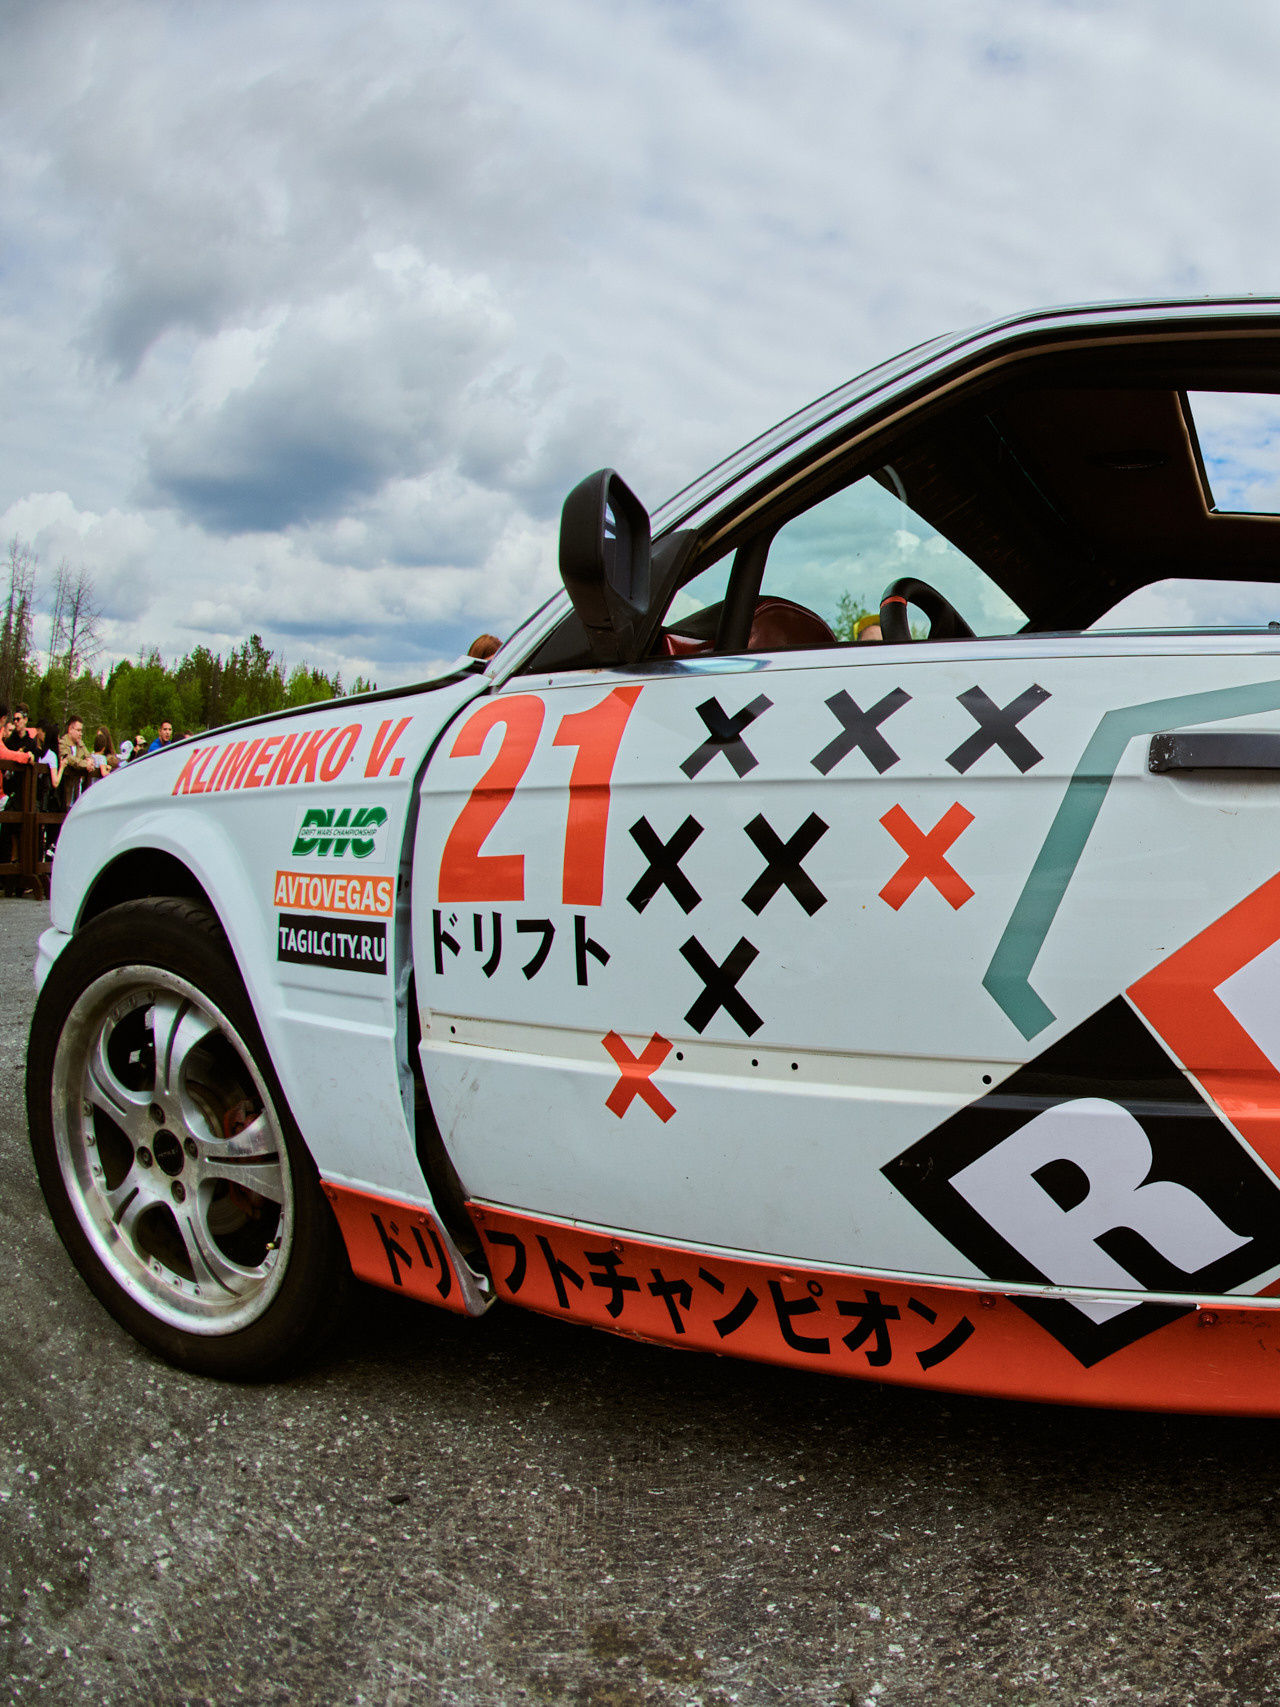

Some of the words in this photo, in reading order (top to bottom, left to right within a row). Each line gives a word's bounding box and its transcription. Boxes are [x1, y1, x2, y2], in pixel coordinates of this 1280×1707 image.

[172, 723, 362, 795] KLIMENKO
[364, 716, 414, 778] V.
[437, 685, 644, 906] 21
[291, 806, 388, 859] DWC
[275, 876, 391, 912] AVTOVEGAS
[279, 927, 386, 962] TAGILCITY.RU
[432, 909, 611, 986] ドリフト
